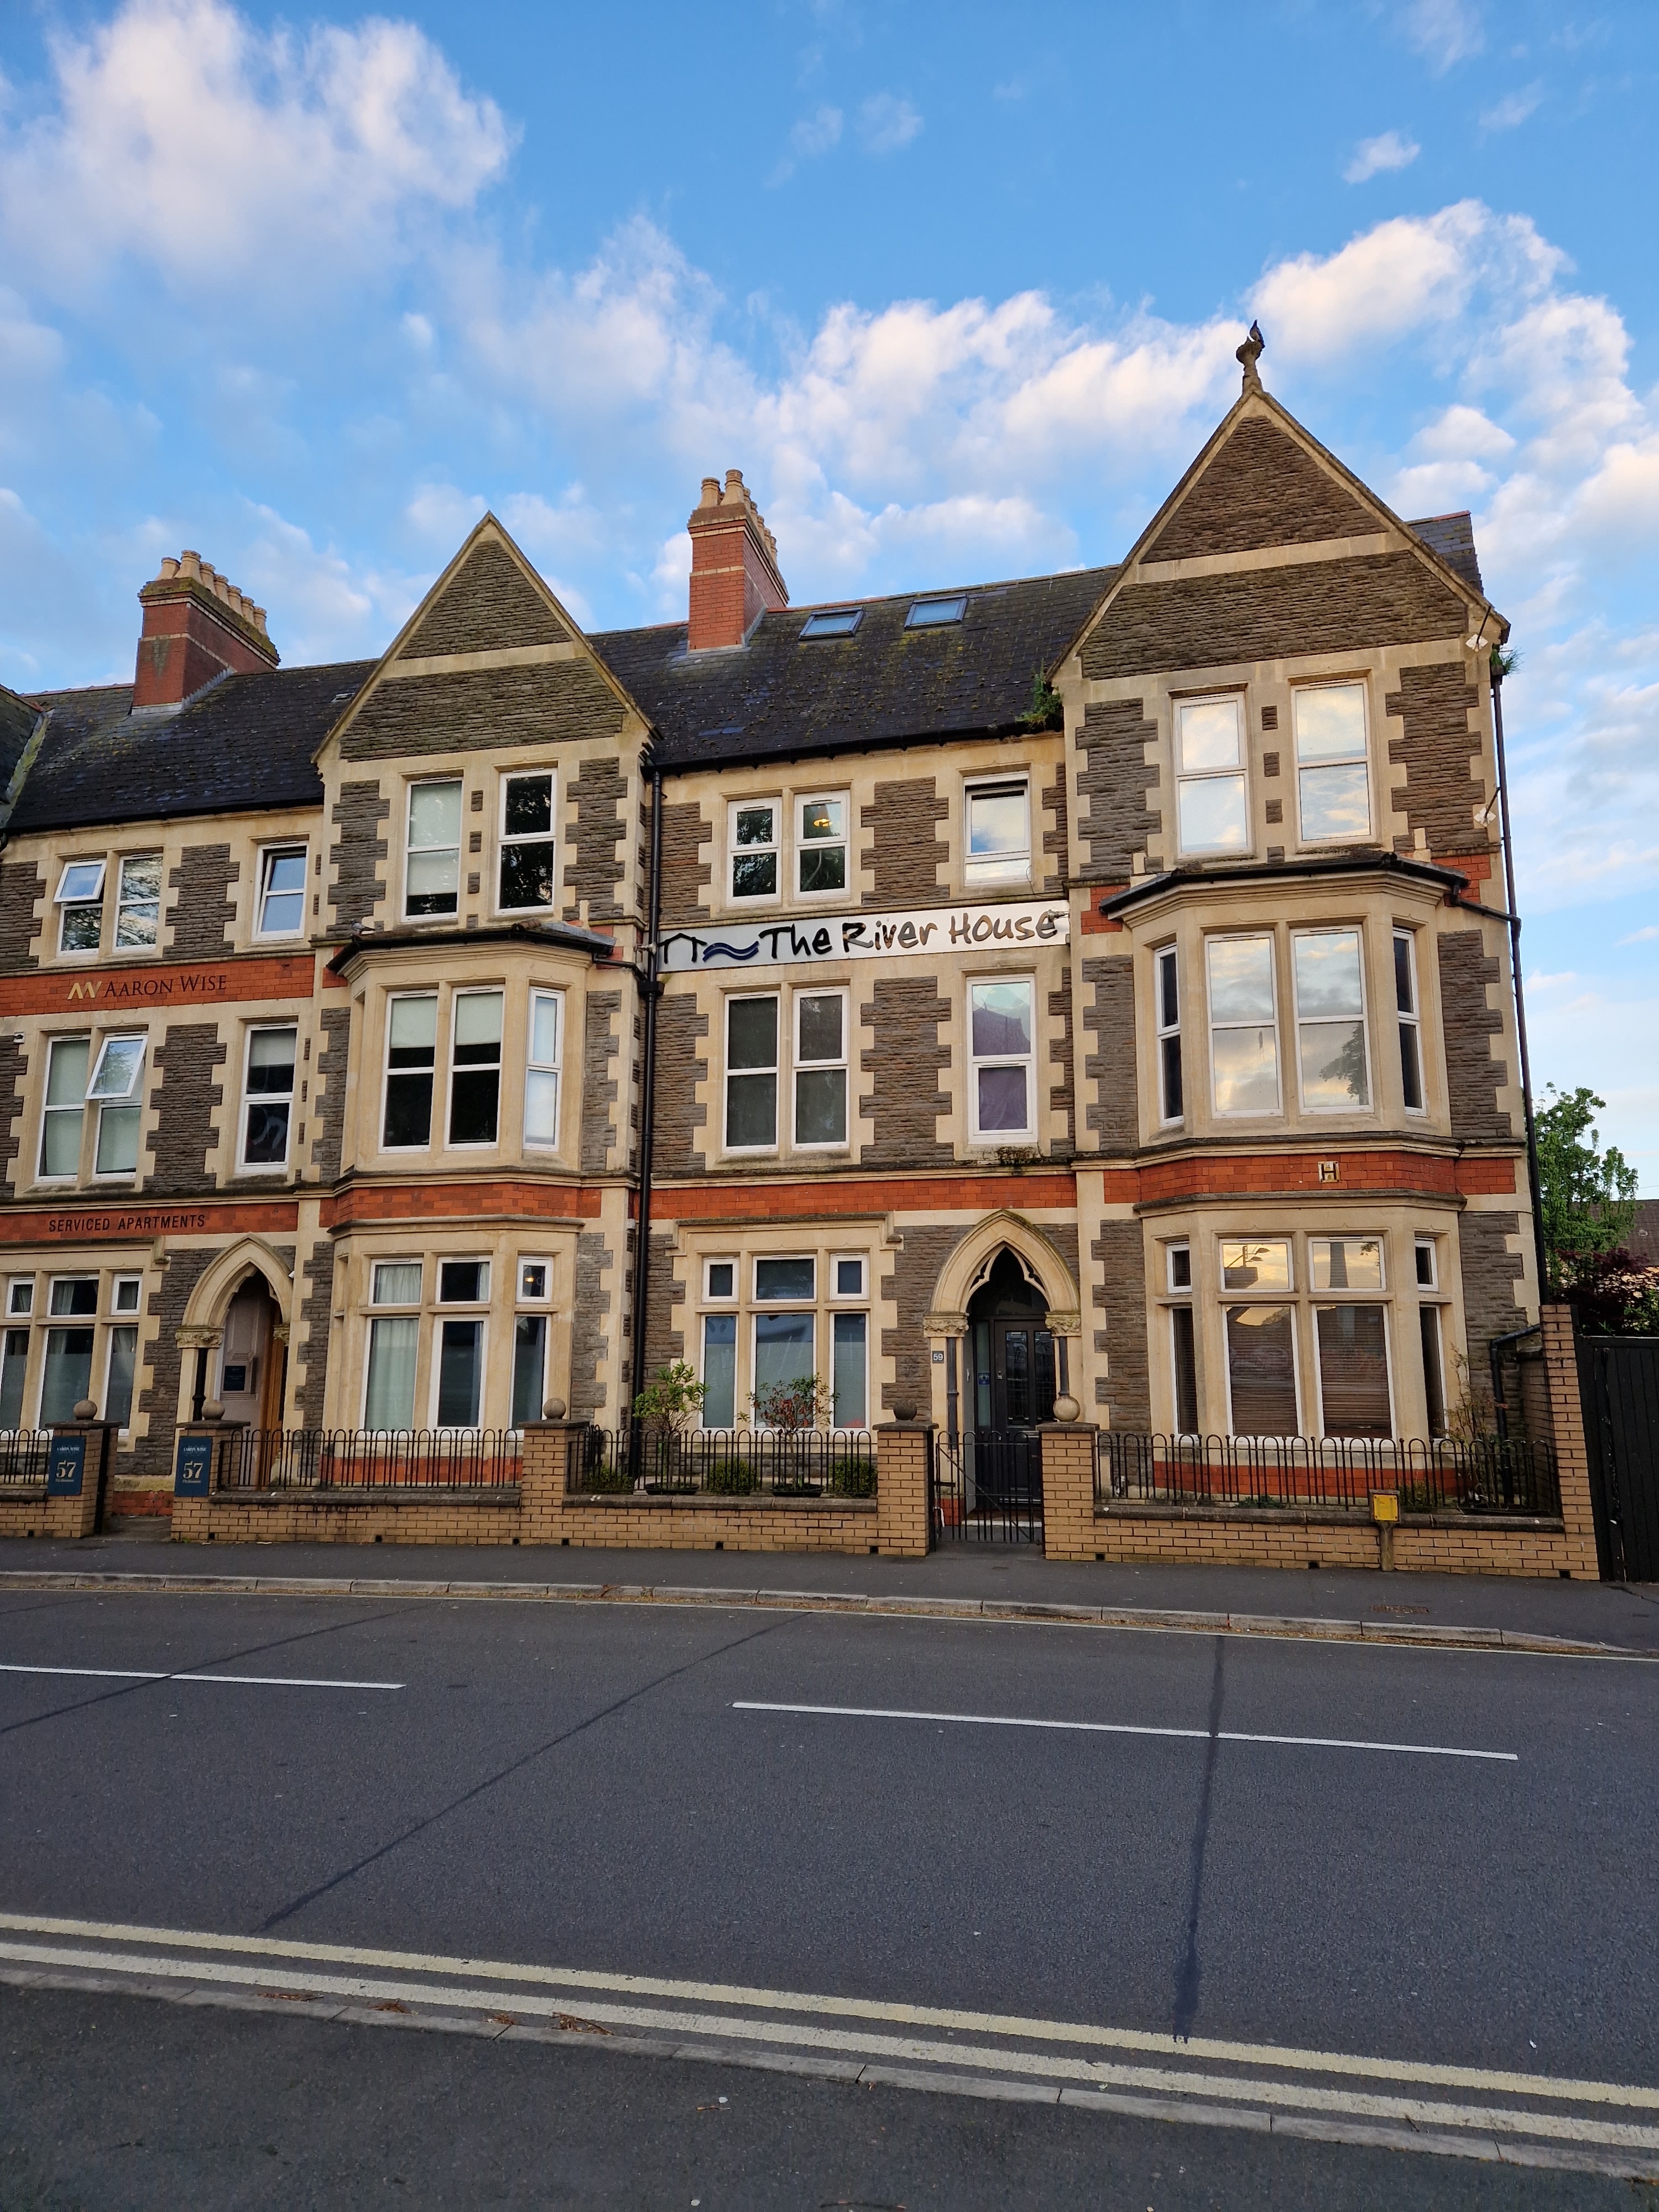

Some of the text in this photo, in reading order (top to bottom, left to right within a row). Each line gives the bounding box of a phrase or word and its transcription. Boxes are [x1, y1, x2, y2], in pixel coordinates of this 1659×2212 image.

[758, 911, 1057, 959] The River House
[103, 974, 226, 998] AARON WISE
[1321, 1162, 1337, 1181] H
[49, 1214, 205, 1232] SERVICED APARTMENTS
[56, 1460, 76, 1478] 57
[182, 1460, 203, 1479] 57
